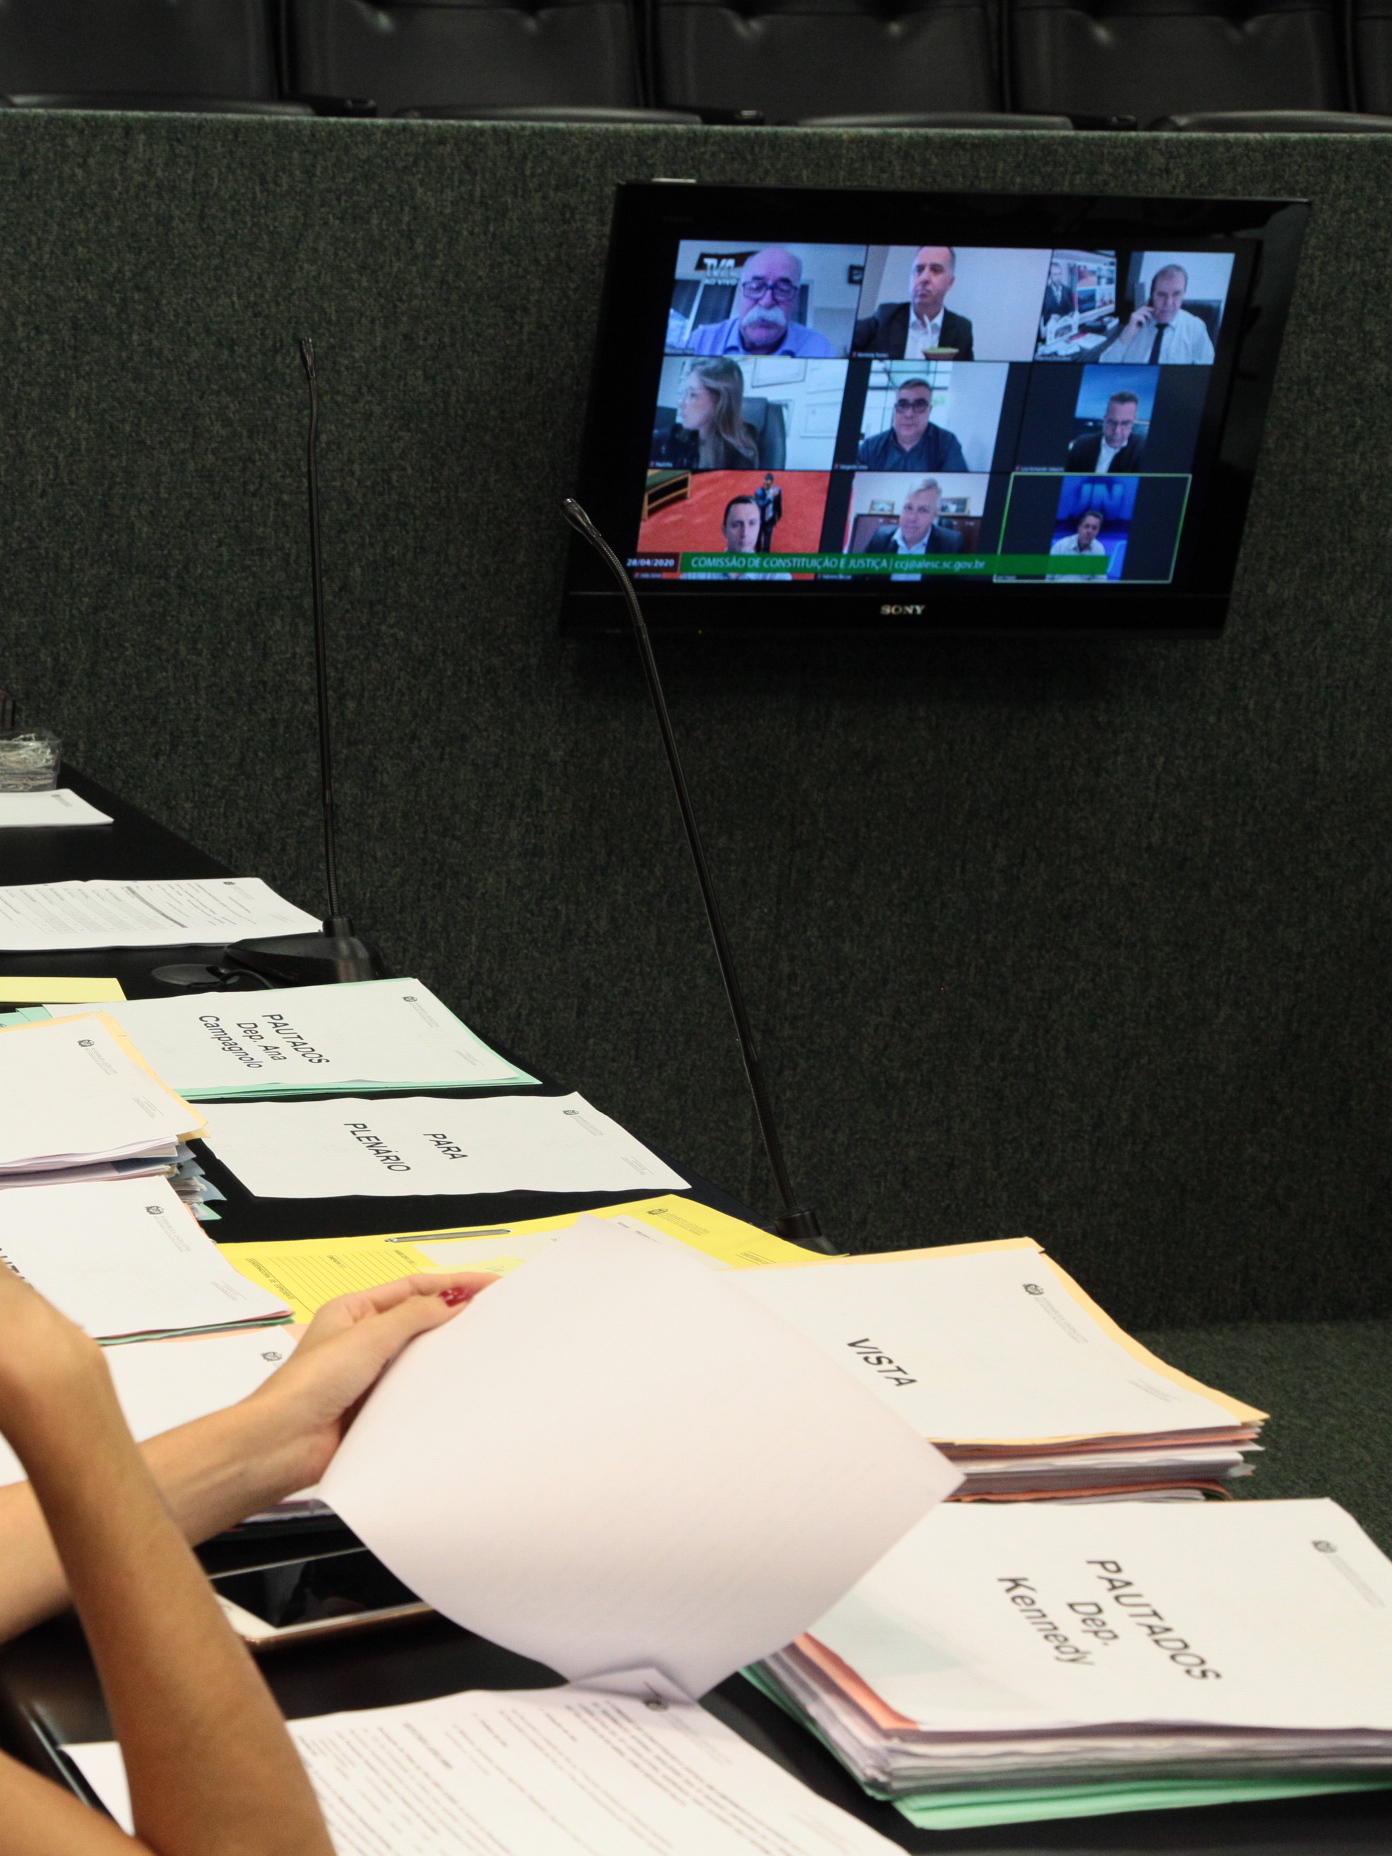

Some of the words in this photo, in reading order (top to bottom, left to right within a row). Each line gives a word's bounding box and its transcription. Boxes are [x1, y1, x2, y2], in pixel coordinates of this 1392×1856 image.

[691, 555, 746, 568] COMISSÃO
[747, 557, 761, 568] DE
[762, 556, 839, 570] CONSTITUIÇÃO
[848, 558, 888, 571] JUSTIÇA
[880, 604, 925, 615] SONY
[198, 1015, 264, 1069] Campagnolo
[236, 1022, 264, 1043] Dep.
[257, 1044, 288, 1061] Ana
[261, 1014, 330, 1064] PAUTADOS
[343, 1122, 411, 1172] PLENÁRIO
[422, 1133, 469, 1160] PARA
[847, 1337, 918, 1387] VISTA
[997, 1577, 1095, 1666] Kennedy
[1066, 1602, 1119, 1647] Dep.
[1086, 1559, 1222, 1680] PAUTADOS
